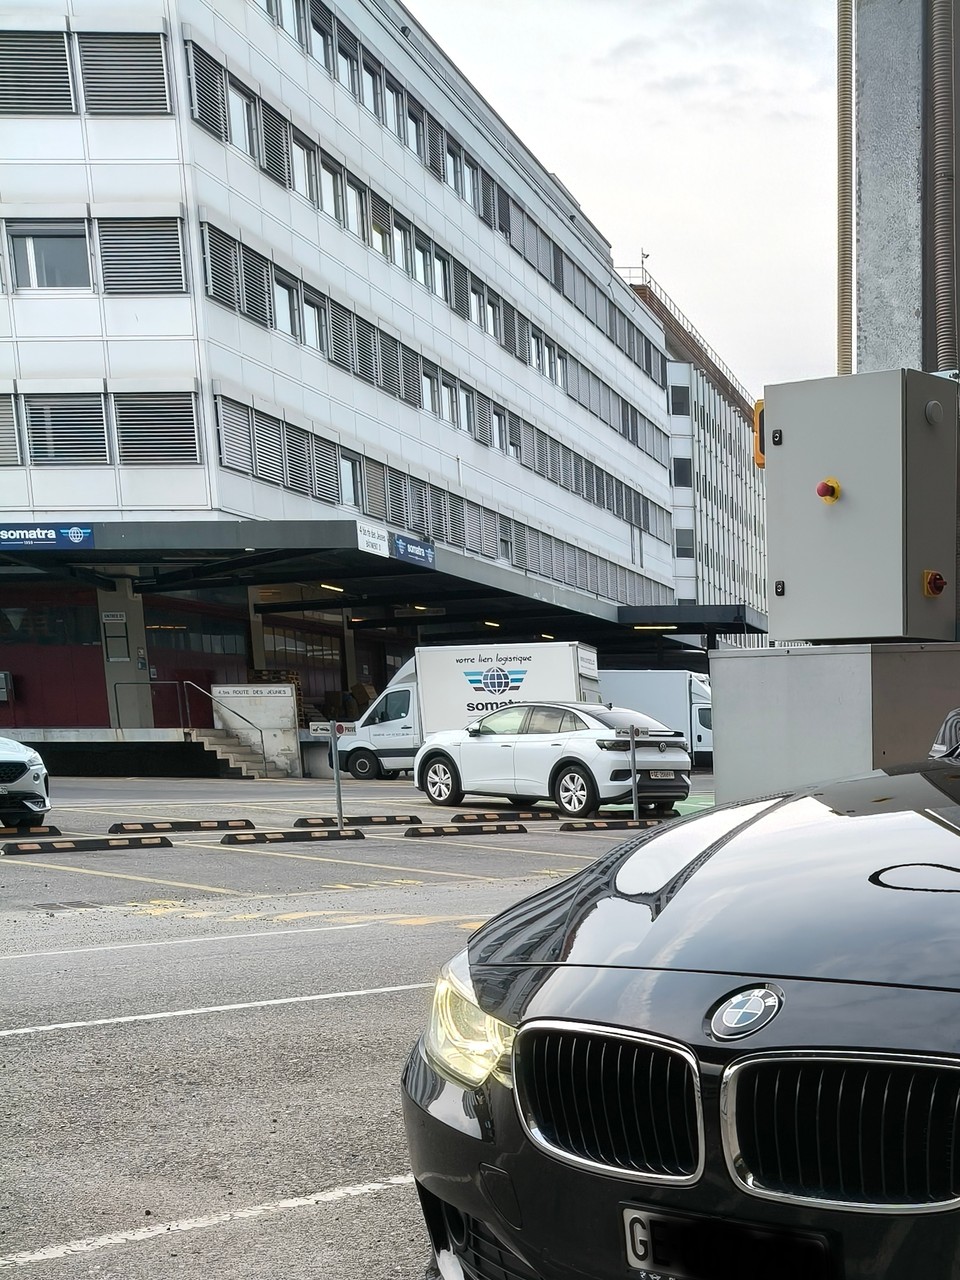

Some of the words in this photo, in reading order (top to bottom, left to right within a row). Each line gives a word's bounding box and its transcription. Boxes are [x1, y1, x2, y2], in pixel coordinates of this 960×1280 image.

[0, 527, 57, 539] somatra
[407, 543, 425, 557] somatra
[455, 656, 475, 664] votre
[478, 654, 493, 663] lien
[495, 653, 532, 666] logistique
